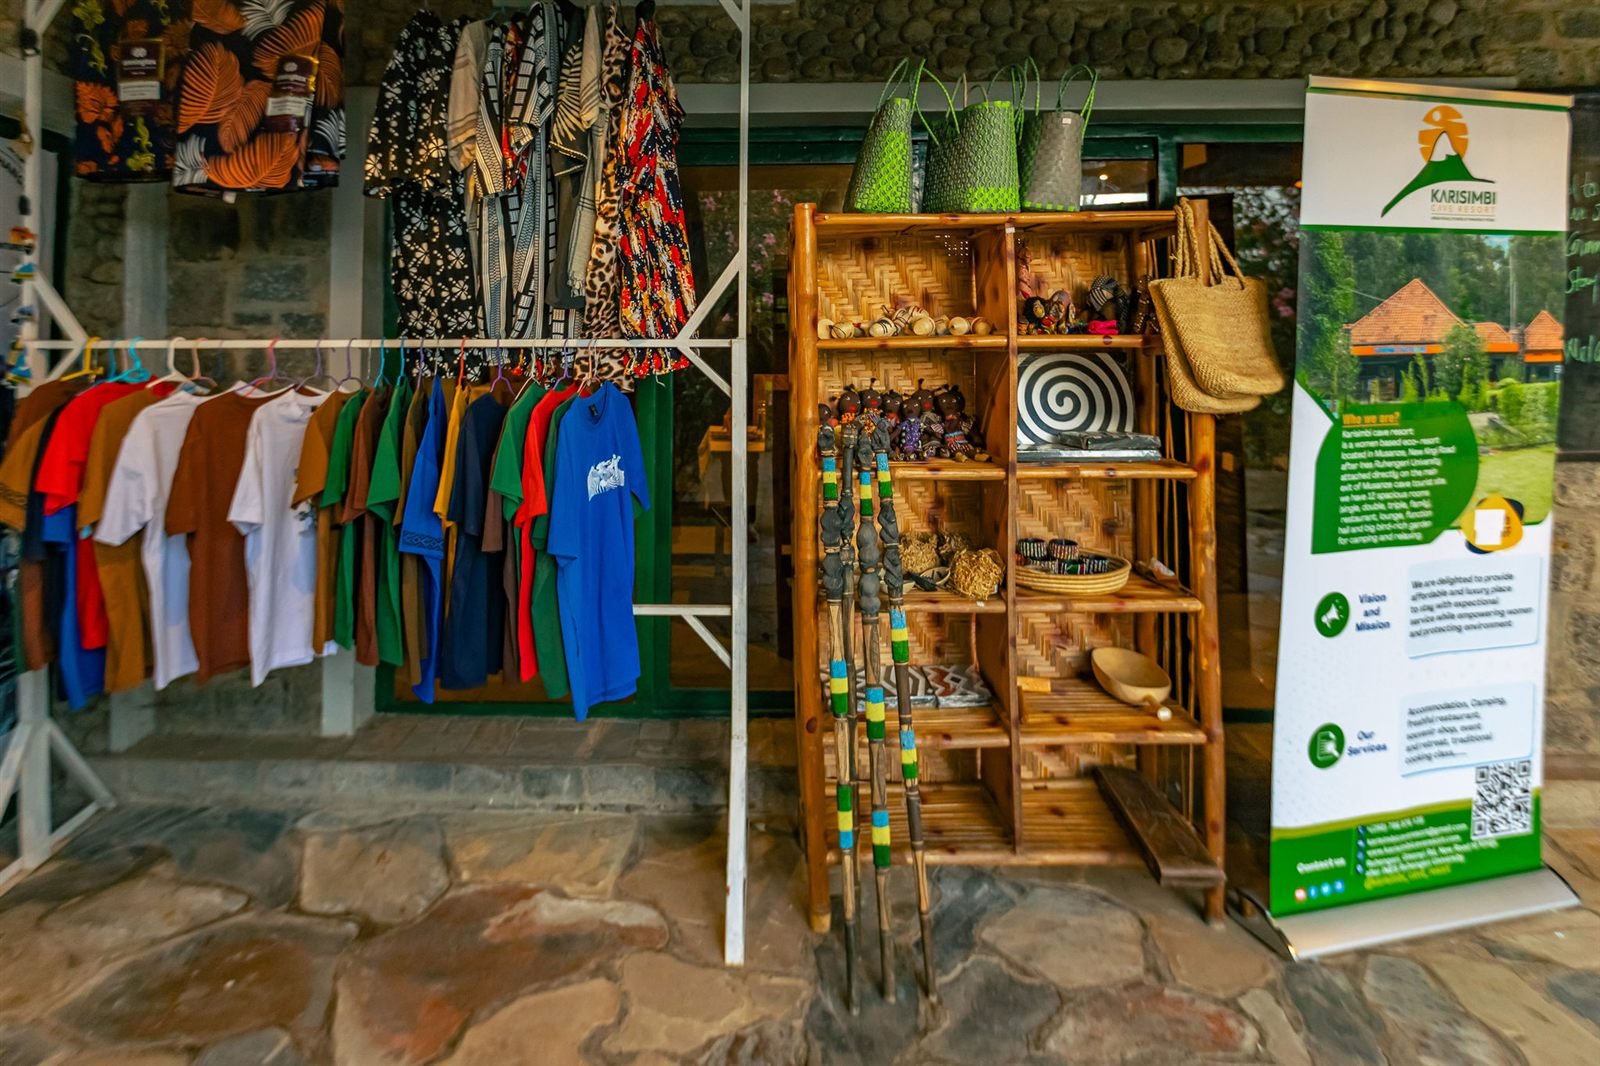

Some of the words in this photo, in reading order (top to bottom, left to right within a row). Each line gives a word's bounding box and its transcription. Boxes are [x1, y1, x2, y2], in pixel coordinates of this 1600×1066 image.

[1430, 189, 1496, 205] KARISIMBI
[1457, 205, 1497, 213] RESORT
[1343, 414, 1361, 425] Who
[1359, 593, 1387, 603] Vision
[1363, 606, 1381, 616] and
[1355, 620, 1391, 632] Mission
[1357, 730, 1375, 741] Our
[1347, 744, 1388, 757] Services
[1297, 857, 1334, 875] Contact
